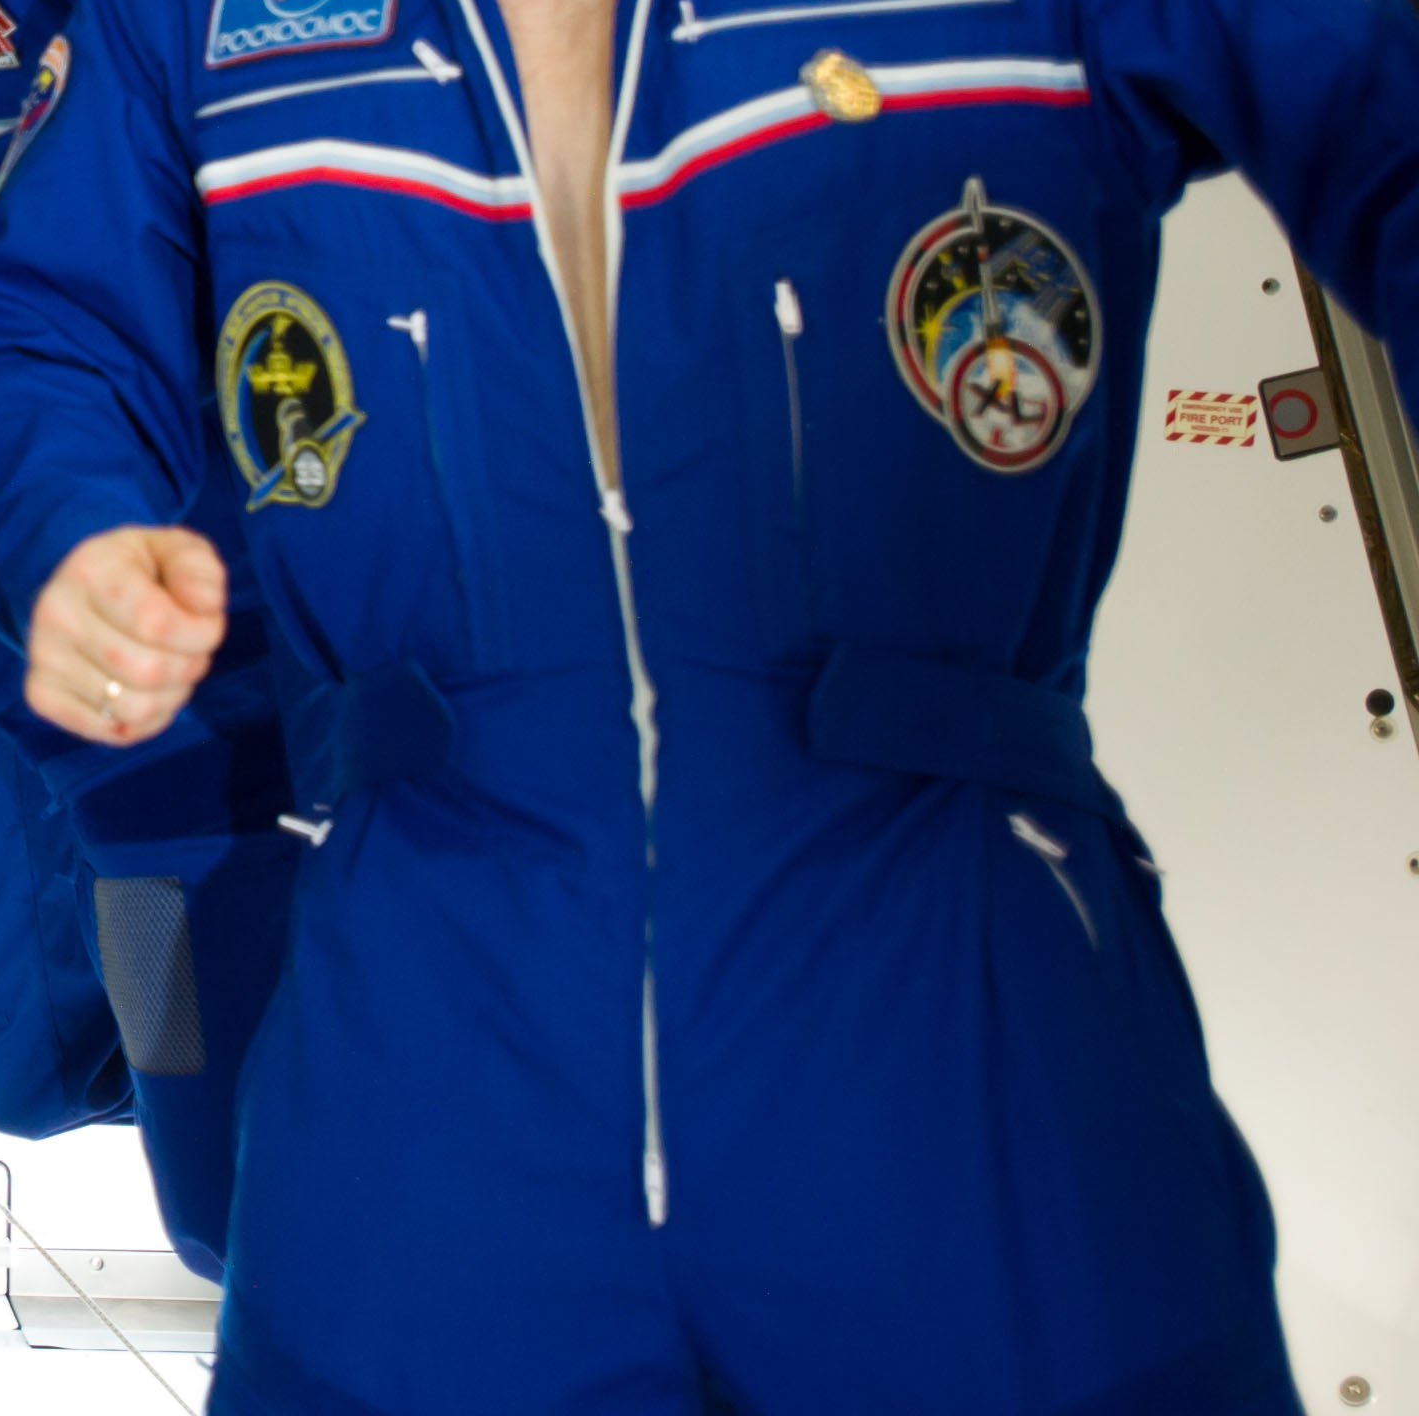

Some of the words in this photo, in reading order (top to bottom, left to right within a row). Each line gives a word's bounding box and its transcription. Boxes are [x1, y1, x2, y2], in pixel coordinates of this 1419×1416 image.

[217, 8, 381, 54] РОСКОСМОС
[1179, 413, 1206, 424] FIRE
[1210, 415, 1244, 426] PORT
